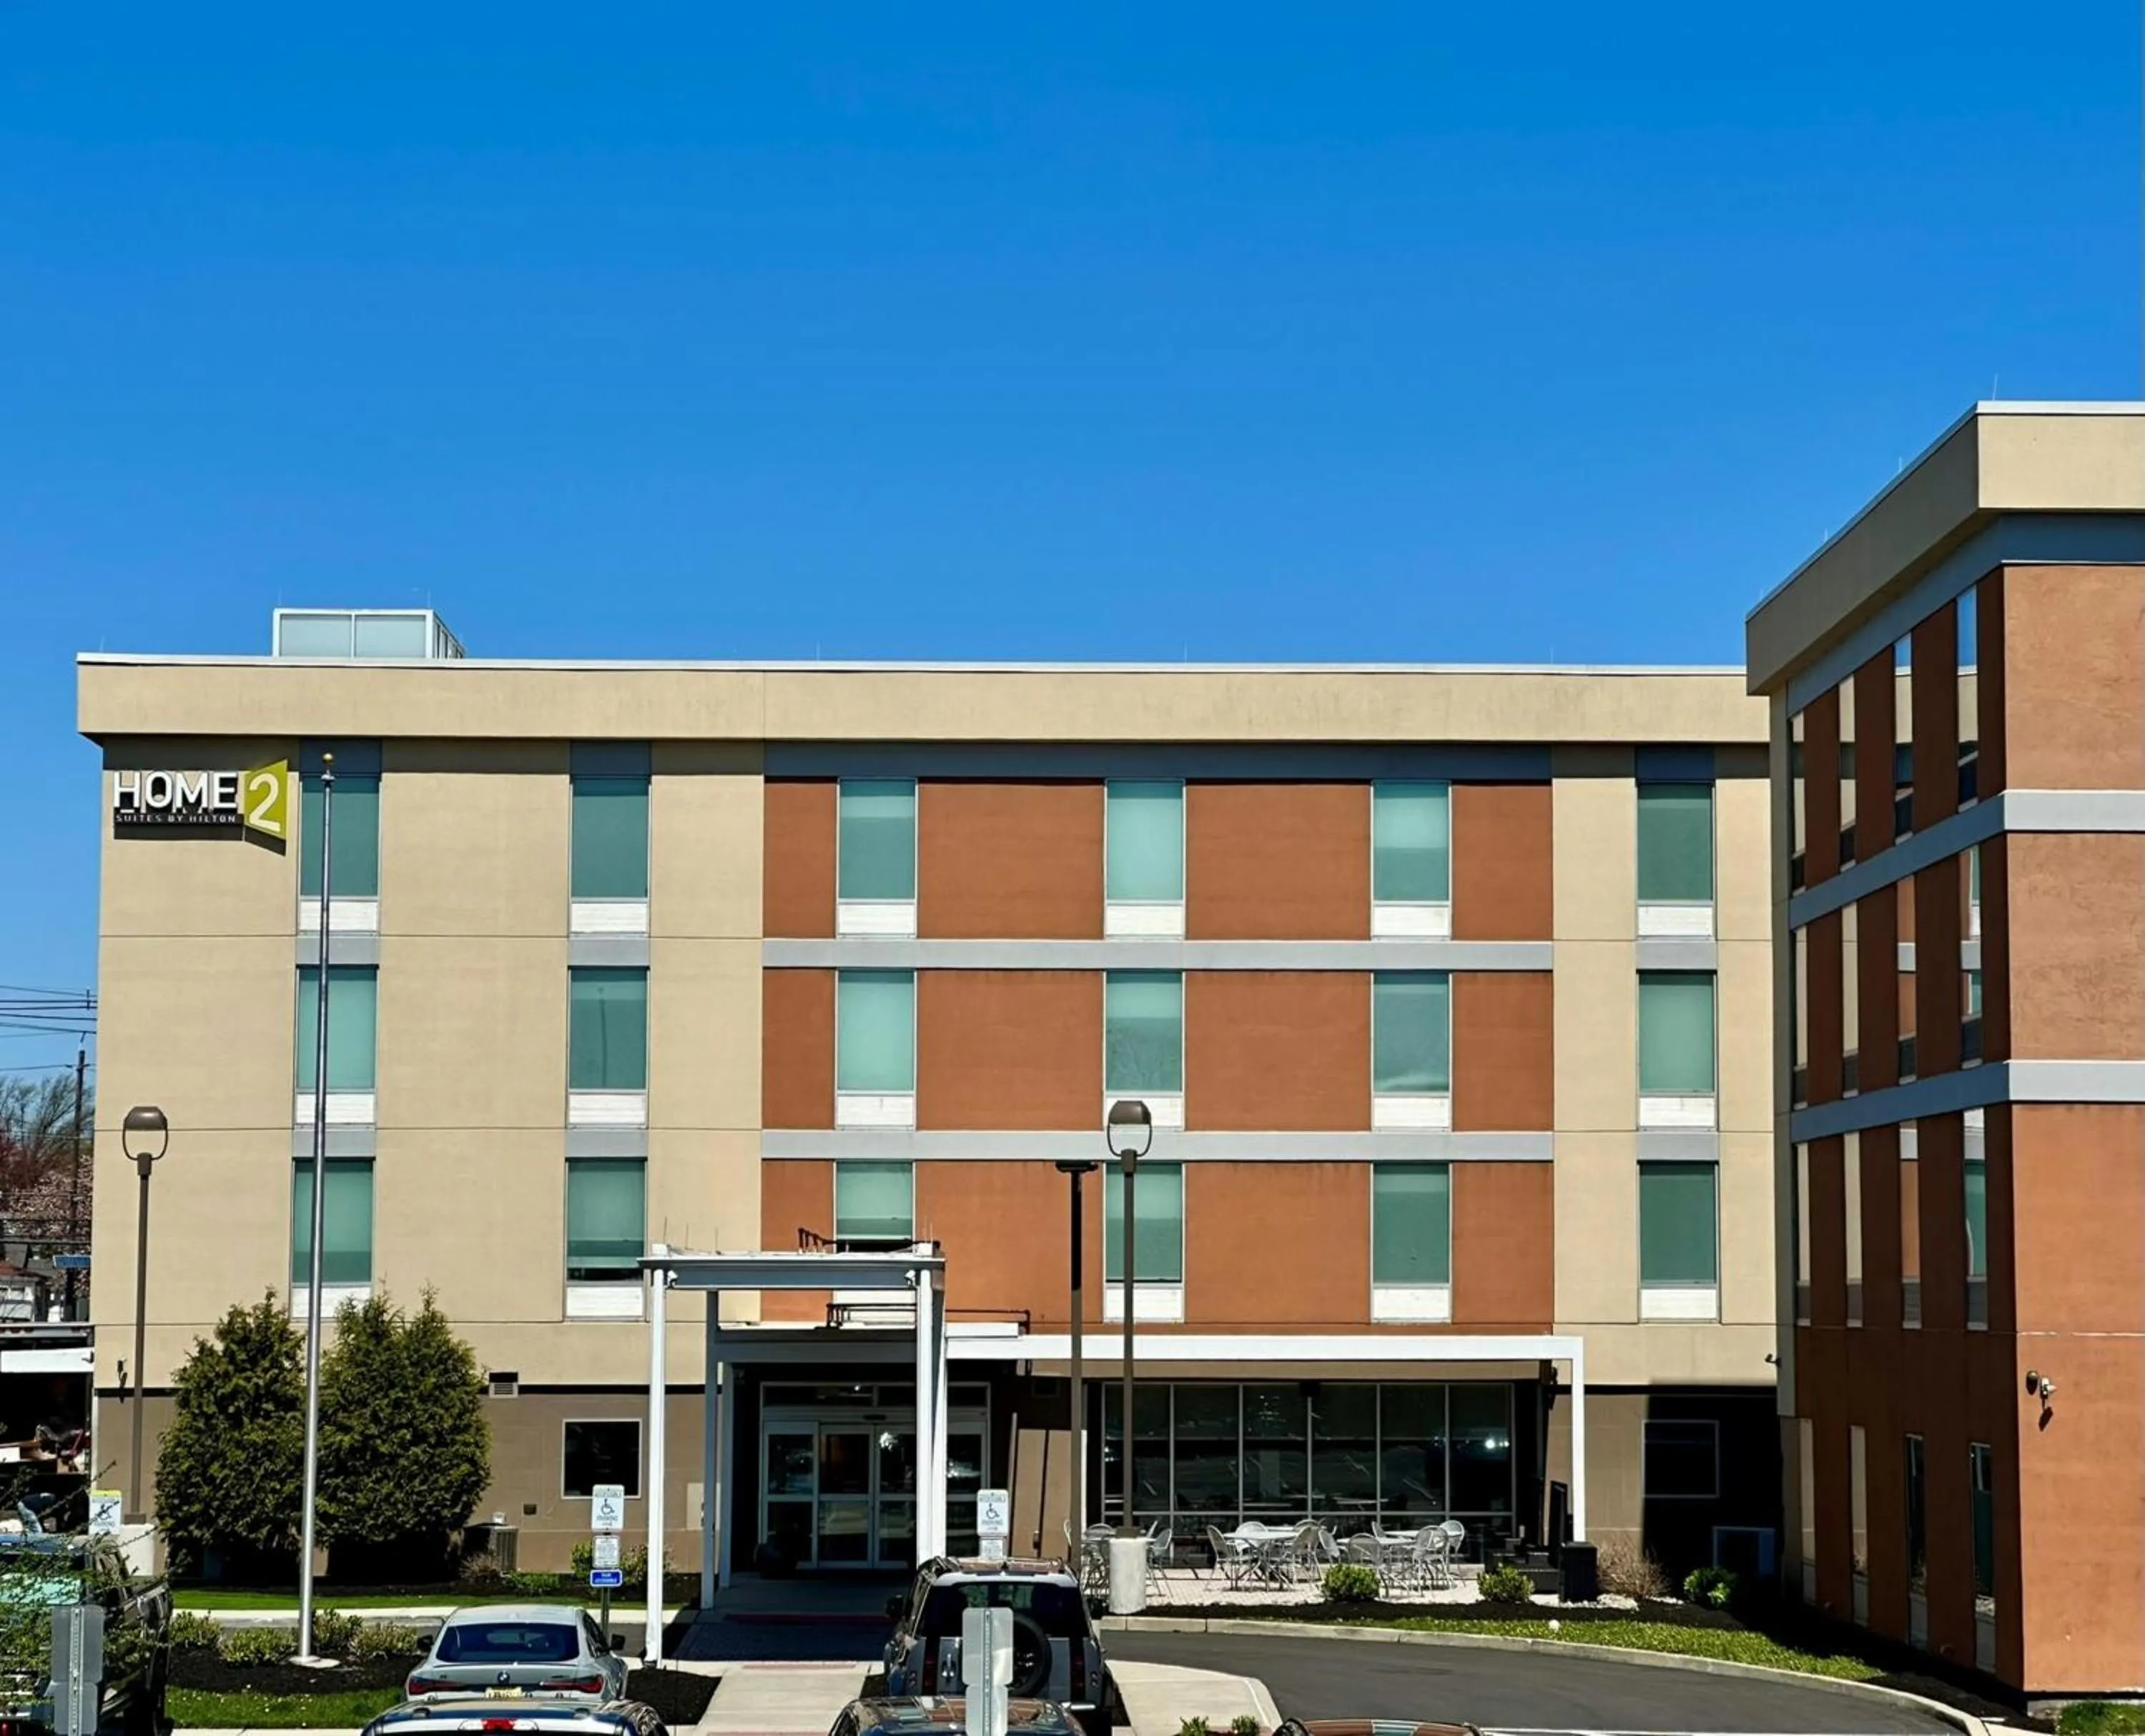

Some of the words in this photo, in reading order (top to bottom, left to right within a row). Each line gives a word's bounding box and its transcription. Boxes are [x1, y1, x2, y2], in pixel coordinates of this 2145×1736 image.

[114, 771, 237, 808] HOME
[249, 773, 281, 832] 2
[116, 814, 162, 823] SUITES
[168, 814, 184, 823] BY
[189, 814, 236, 823] HILTON
